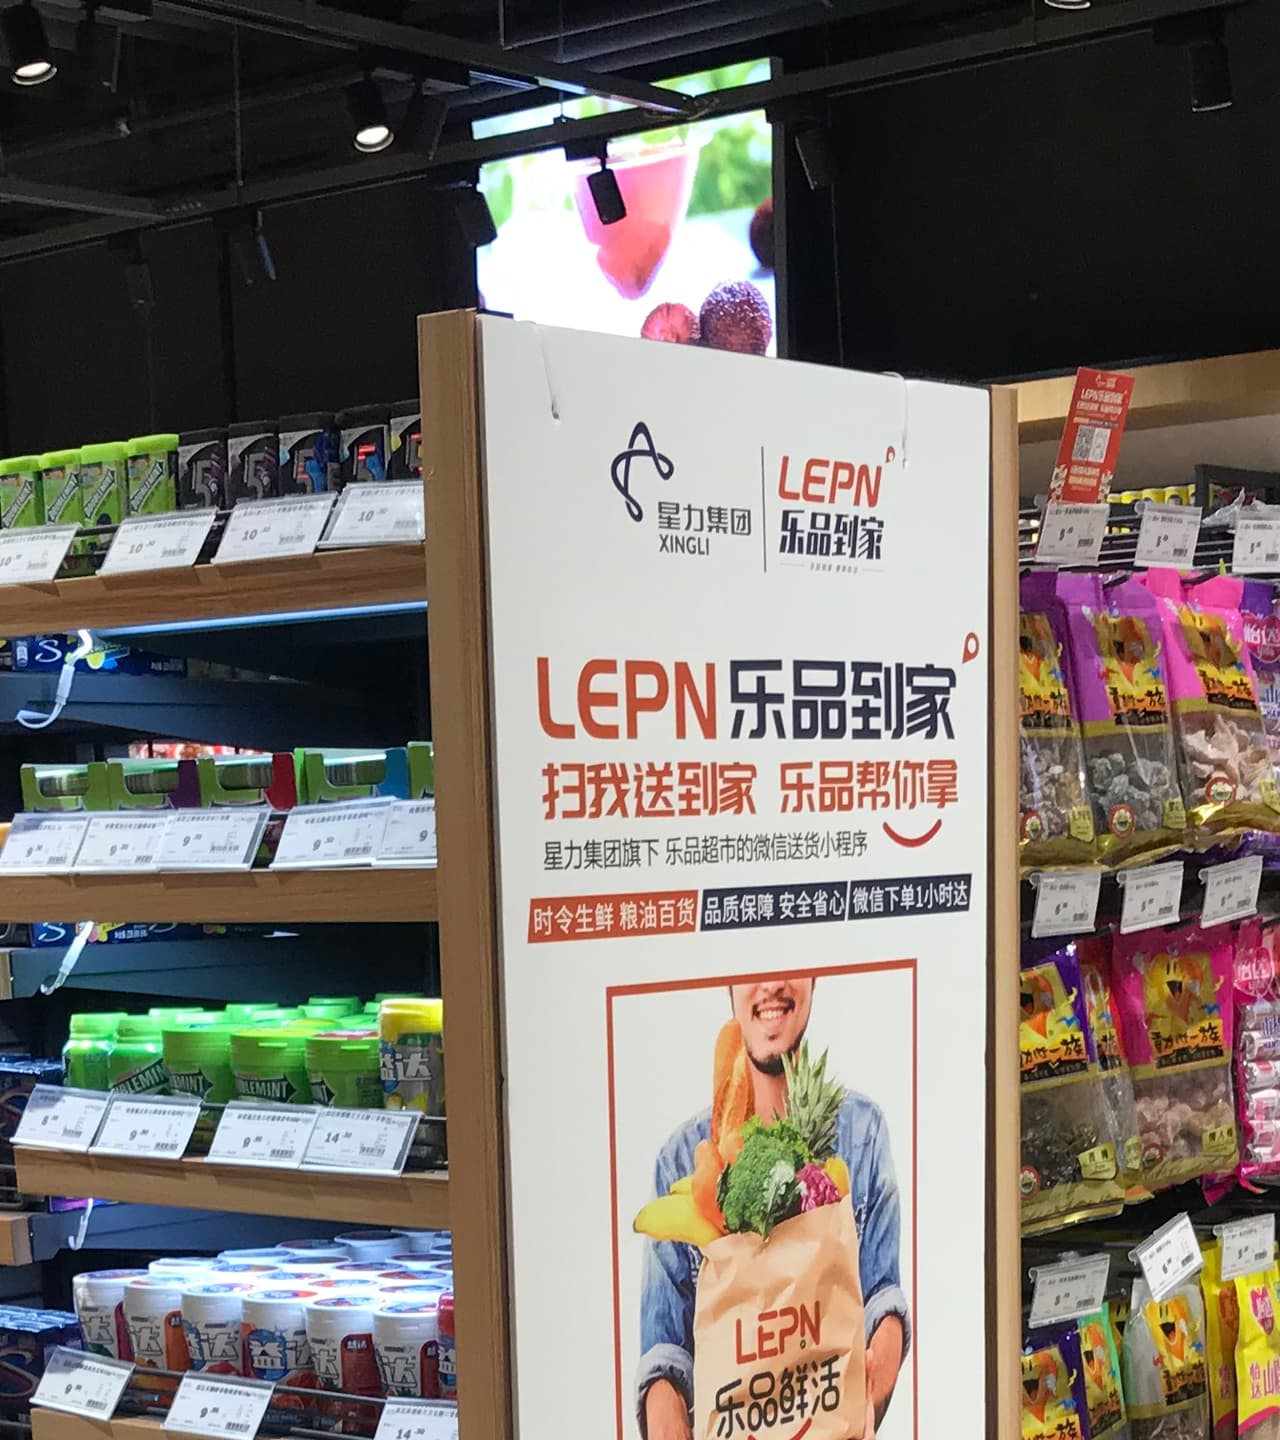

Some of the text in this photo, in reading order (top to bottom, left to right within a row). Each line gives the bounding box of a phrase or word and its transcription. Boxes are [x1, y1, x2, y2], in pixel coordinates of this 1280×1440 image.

[778, 456, 882, 507] LEPN
[658, 501, 751, 536] 星力集团
[659, 534, 710, 556] XINGLI
[779, 509, 884, 560] 乐品到家
[536, 656, 957, 740] LEPN 乐品到家
[541, 758, 960, 820] 扫我送到家 乐品帮你拿
[543, 828, 869, 872] 星力集团旗下 乐品超市的微信送货小程序
[533, 880, 969, 937] 时令生鲜 粮油百货 品质保障 安全省心 微信下单1小时达
[736, 1300, 820, 1364] LEPN
[715, 1355, 841, 1439] 乐品鲜活
